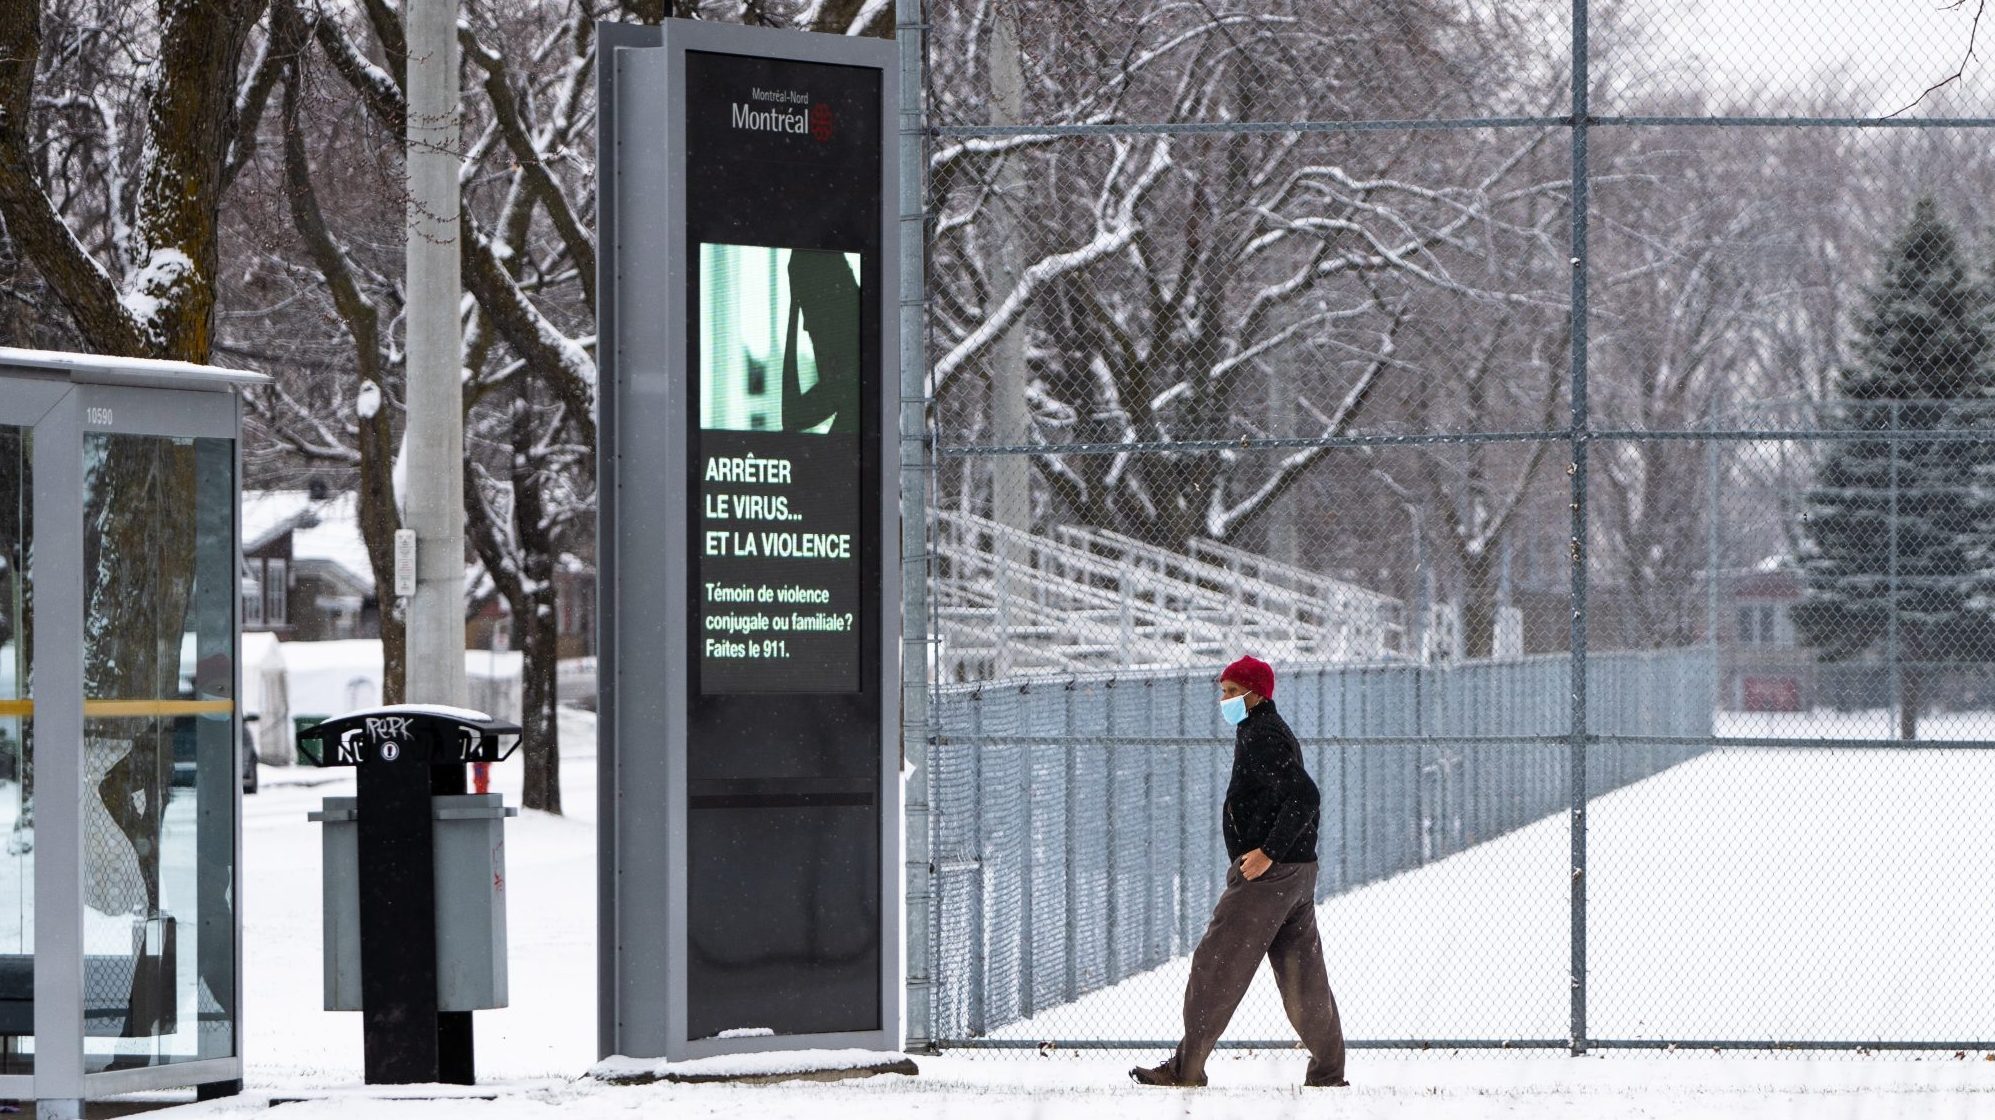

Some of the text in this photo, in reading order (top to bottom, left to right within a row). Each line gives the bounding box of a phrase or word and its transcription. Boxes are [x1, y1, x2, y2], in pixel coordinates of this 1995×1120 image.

[752, 87, 809, 104] Montréal-Nord
[732, 102, 809, 134] Montréal
[86, 407, 113, 425] 10590
[705, 451, 792, 484] ARRÊTER
[705, 494, 802, 520] LE VIRUS...
[705, 531, 851, 558] ET LA VIOLENCE
[705, 582, 830, 603] Témoin de violence
[705, 611, 853, 634] conjugale ou familiale?
[705, 639, 790, 658] Faites le 911.
